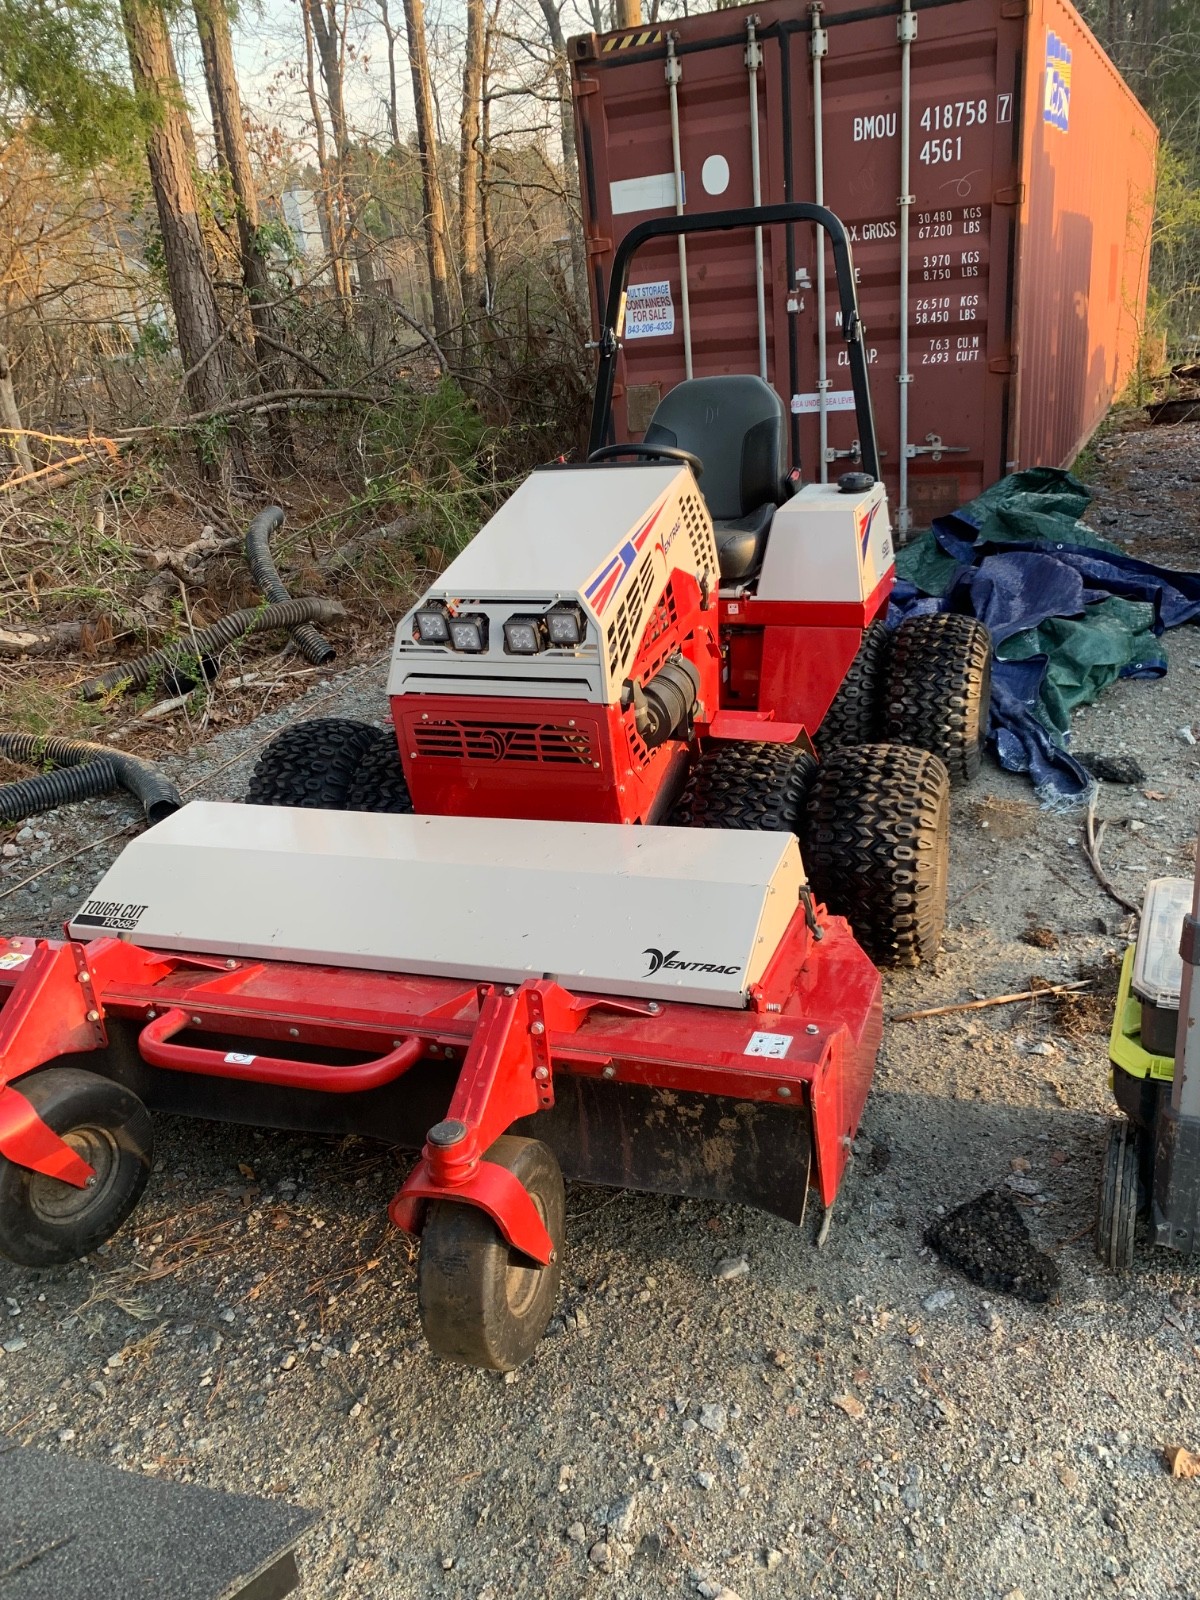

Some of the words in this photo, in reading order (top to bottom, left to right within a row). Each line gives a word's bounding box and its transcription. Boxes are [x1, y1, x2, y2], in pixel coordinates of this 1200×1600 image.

[853, 112, 897, 142] BMOU
[920, 99, 988, 132] 418758
[999, 95, 1010, 121] 7
[919, 136, 962, 165] 45G1
[918, 210, 953, 224] 30.480
[963, 206, 982, 219] KGS
[862, 221, 897, 241] GROSS
[918, 224, 953, 239] 67.200
[963, 220, 981, 235] LBS
[923, 254, 951, 268] 3.970
[961, 251, 980, 265] KGS
[923, 268, 951, 281] 8.750
[961, 265, 978, 278] LBS
[642, 284, 669, 297] STORAGE
[626, 296, 671, 311] CONTAINERS
[916, 297, 950, 310] 26.510
[960, 294, 979, 307] KGS
[632, 310, 647, 322] FOR
[648, 308, 667, 321] SALE
[915, 310, 949, 325] 58.450
[959, 309, 976, 321] LBS
[929, 338, 950, 351] 76.3
[922, 352, 949, 365] 2.693
[804, 399, 821, 408] UNDE
[82, 900, 124, 917] TOUGH
[120, 904, 149, 919] CUT
[101, 917, 139, 929] HQ682
[641, 948, 742, 978] VENTRAC
